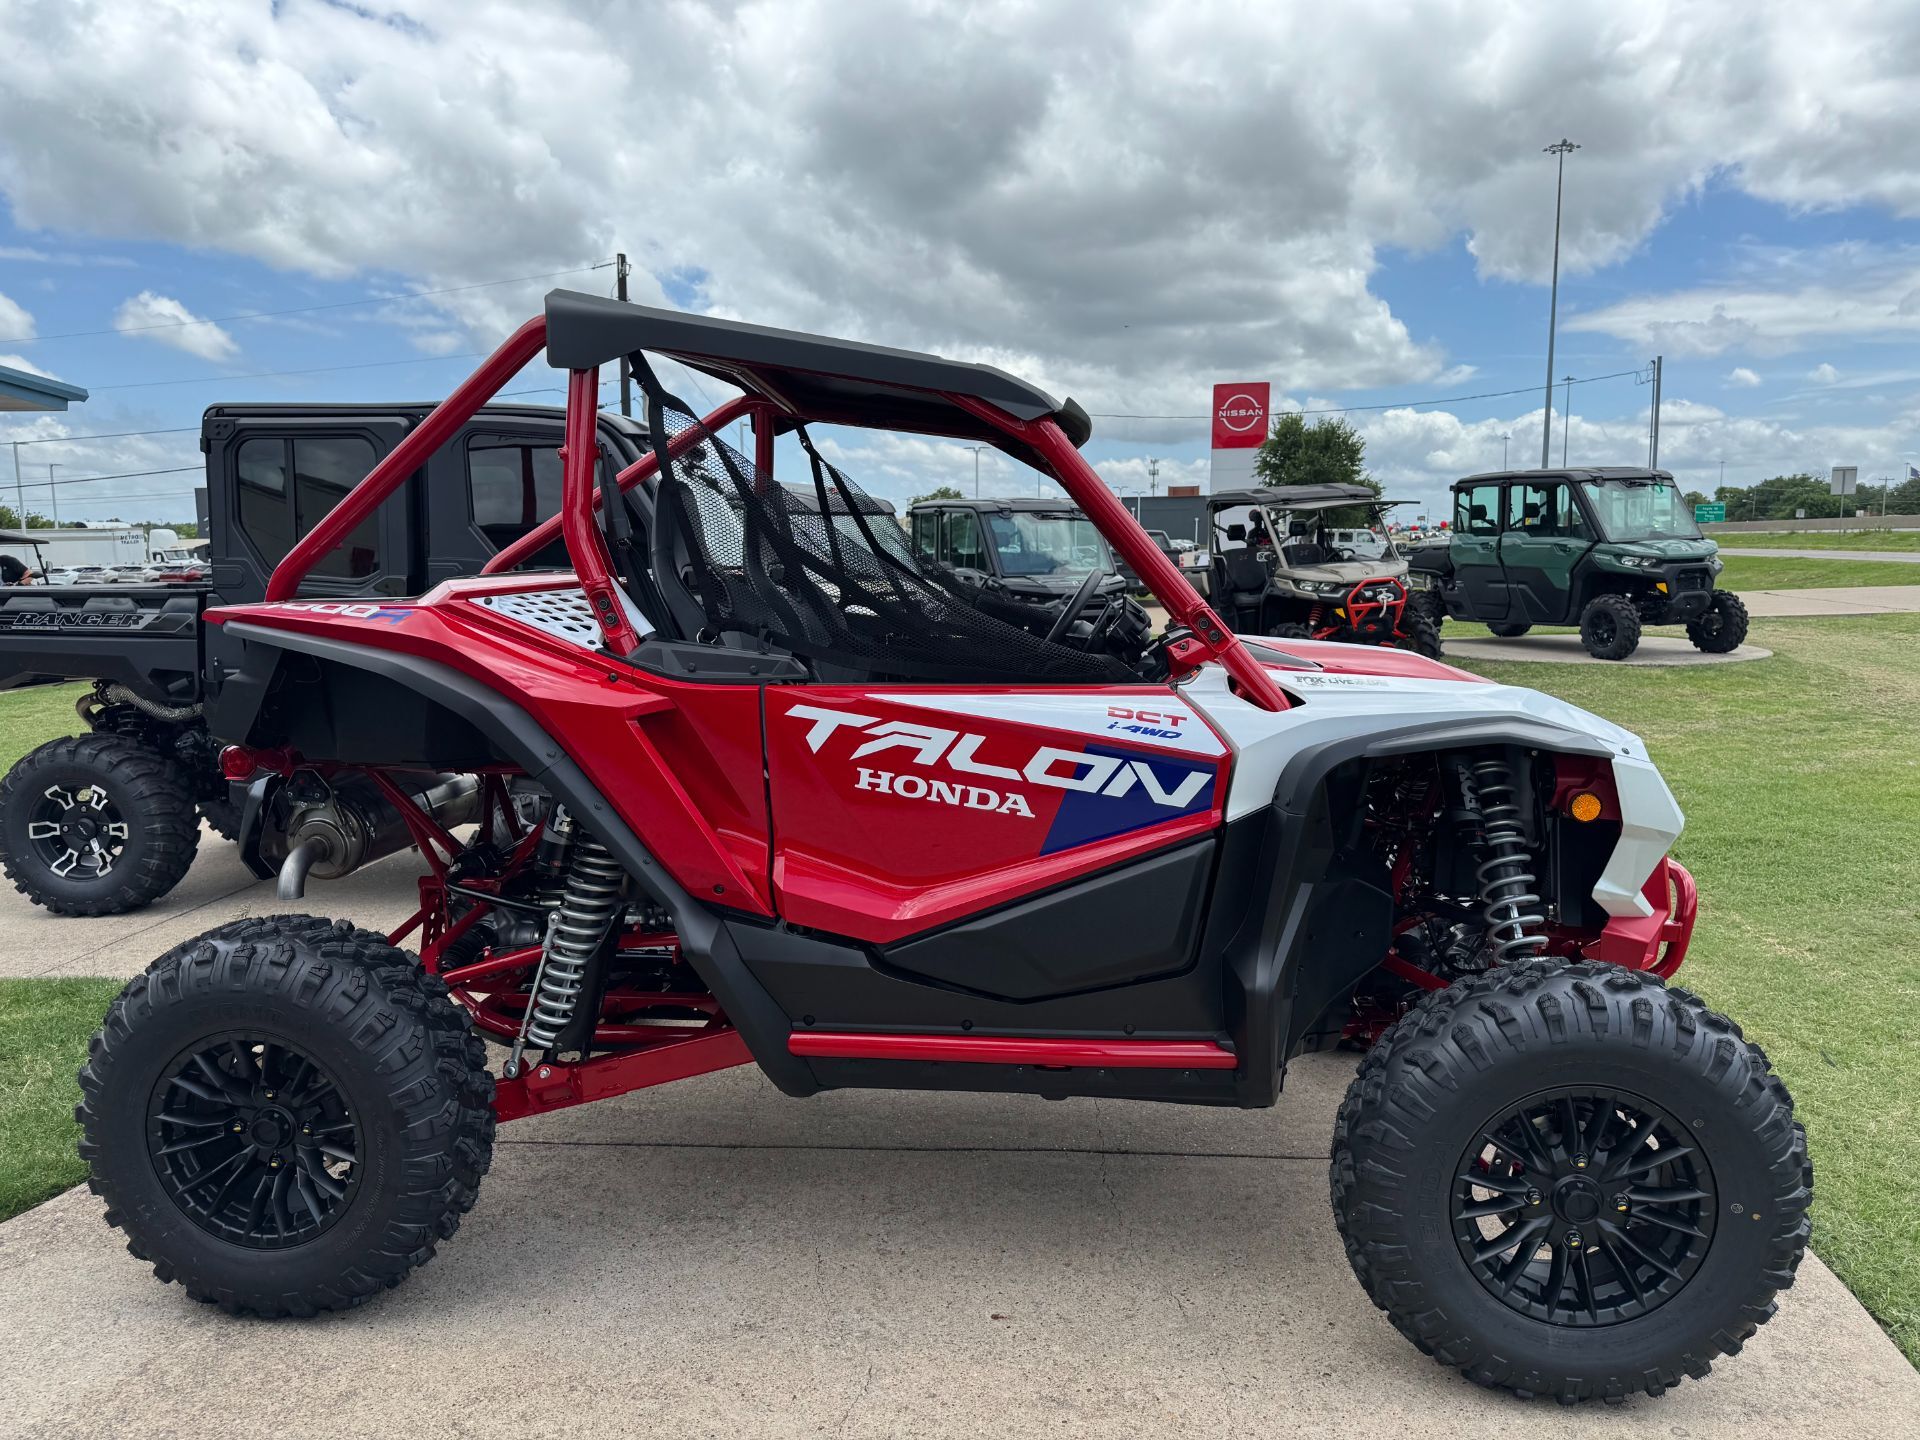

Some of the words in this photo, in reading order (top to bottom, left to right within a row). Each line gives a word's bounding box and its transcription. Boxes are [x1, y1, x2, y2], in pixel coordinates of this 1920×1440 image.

[1218, 408, 1263, 417] NISSAN
[13, 612, 145, 627] RANGER
[1294, 675, 1326, 686] FOX
[1107, 706, 1188, 727] DCT
[1106, 721, 1183, 739] i-4WD
[784, 703, 1213, 809] TALON
[854, 766, 1036, 818] HONDA
[553, 803, 573, 833] FO
